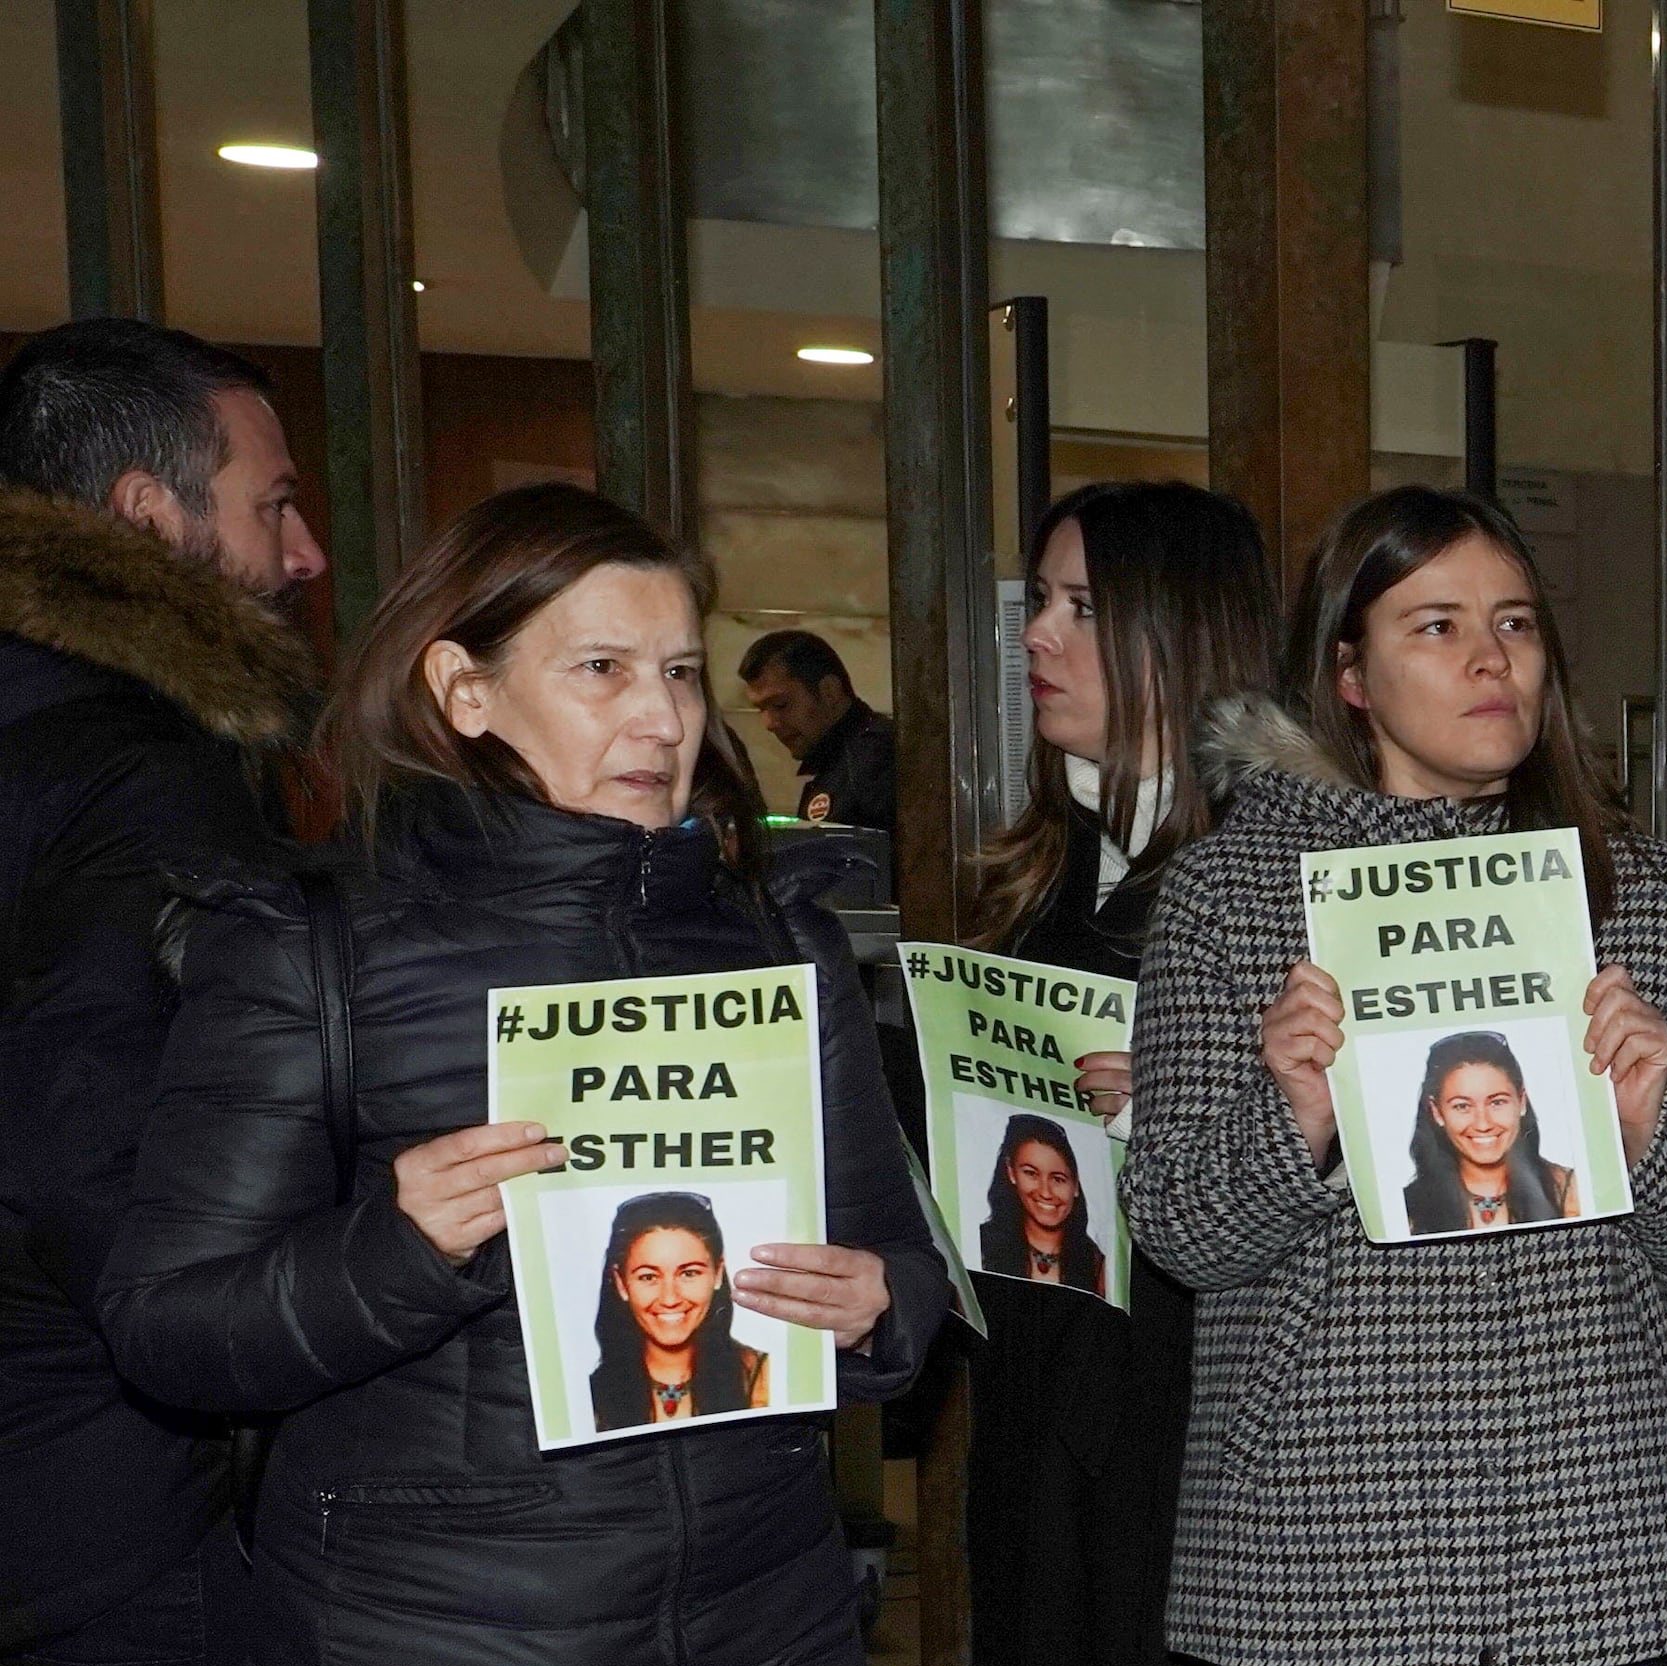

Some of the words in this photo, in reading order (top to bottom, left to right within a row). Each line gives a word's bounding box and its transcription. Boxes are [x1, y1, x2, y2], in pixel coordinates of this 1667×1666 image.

[1307, 848, 1573, 904] #JUSTICIA
[1377, 914, 1516, 958] PARA
[496, 984, 803, 1044] #JUSTICIA
[906, 951, 1127, 1025] #JUSTICIA
[1351, 971, 1555, 1021] ESTHER
[967, 1009, 1065, 1065] PARA
[571, 1062, 738, 1104] PARA
